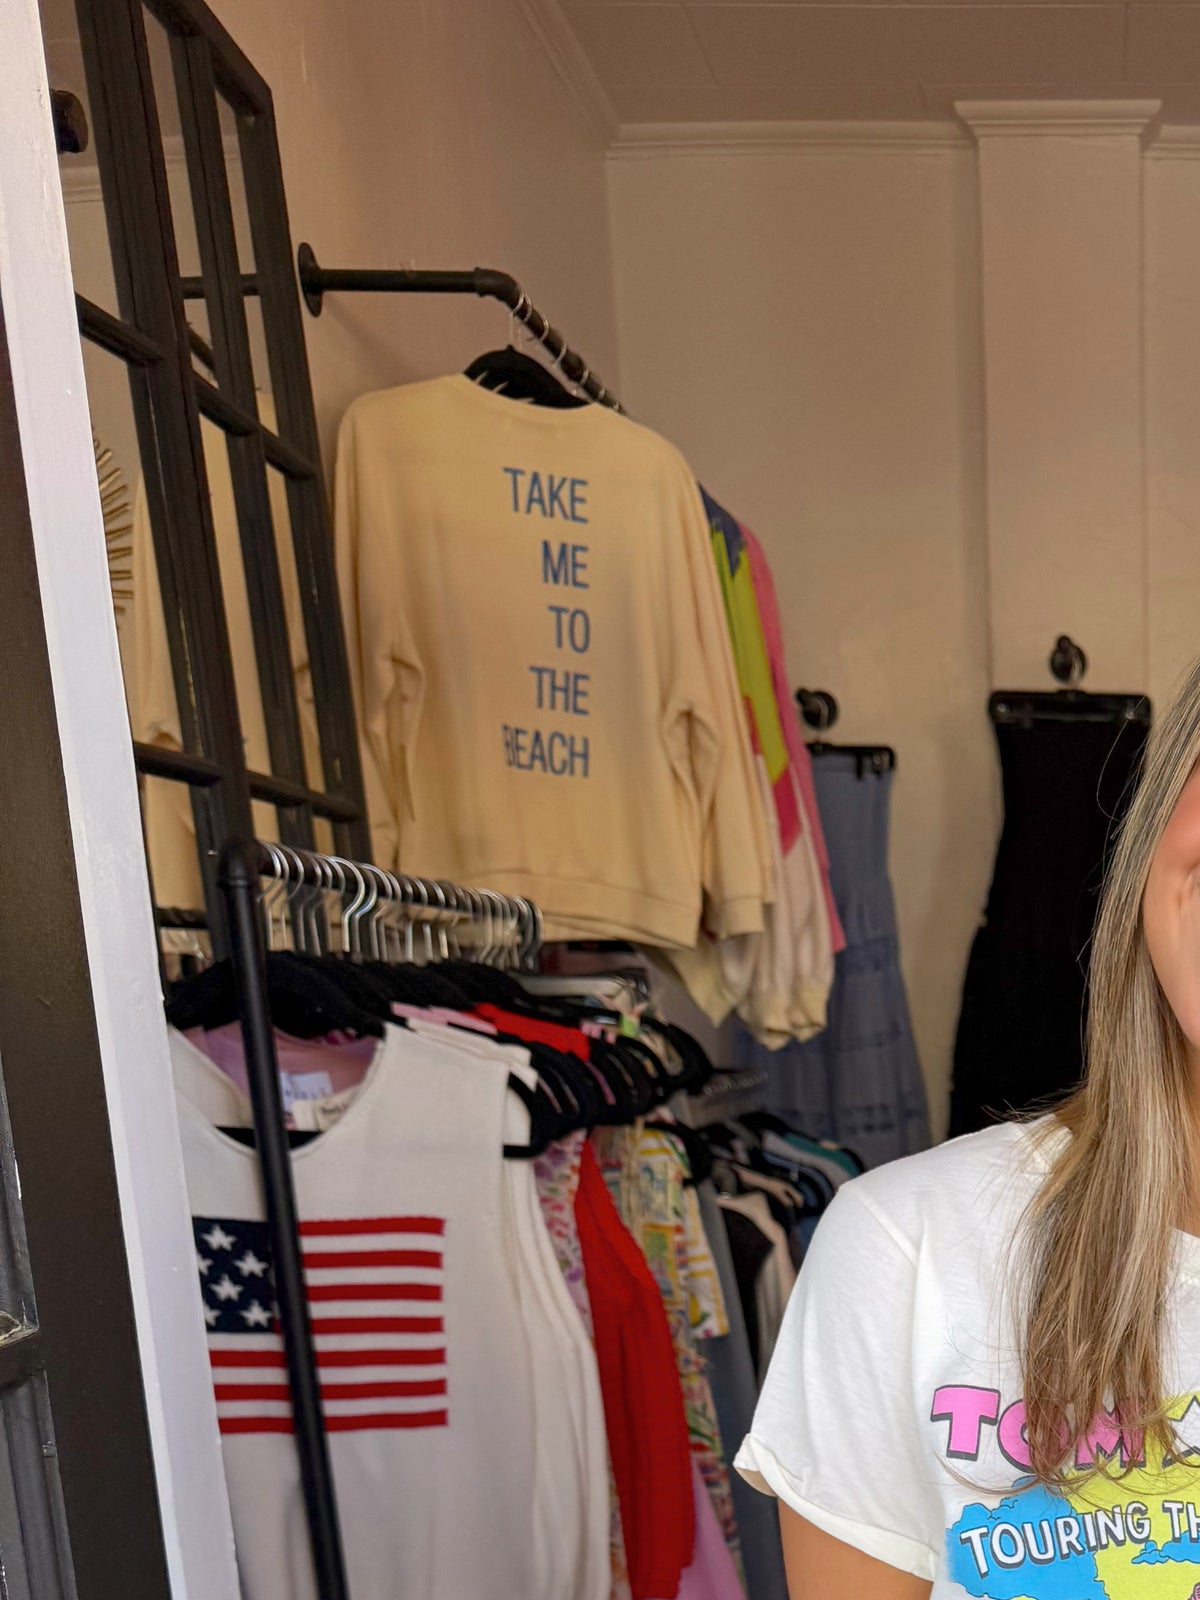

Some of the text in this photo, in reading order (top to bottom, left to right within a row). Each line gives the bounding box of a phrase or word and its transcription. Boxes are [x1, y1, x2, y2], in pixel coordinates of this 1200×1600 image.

[502, 466, 589, 524] TAKE
[541, 540, 589, 589] ME
[548, 605, 591, 653] TO
[529, 666, 590, 716] THE
[502, 724, 590, 778] BEACH
[961, 1503, 1151, 1578] TOURING
